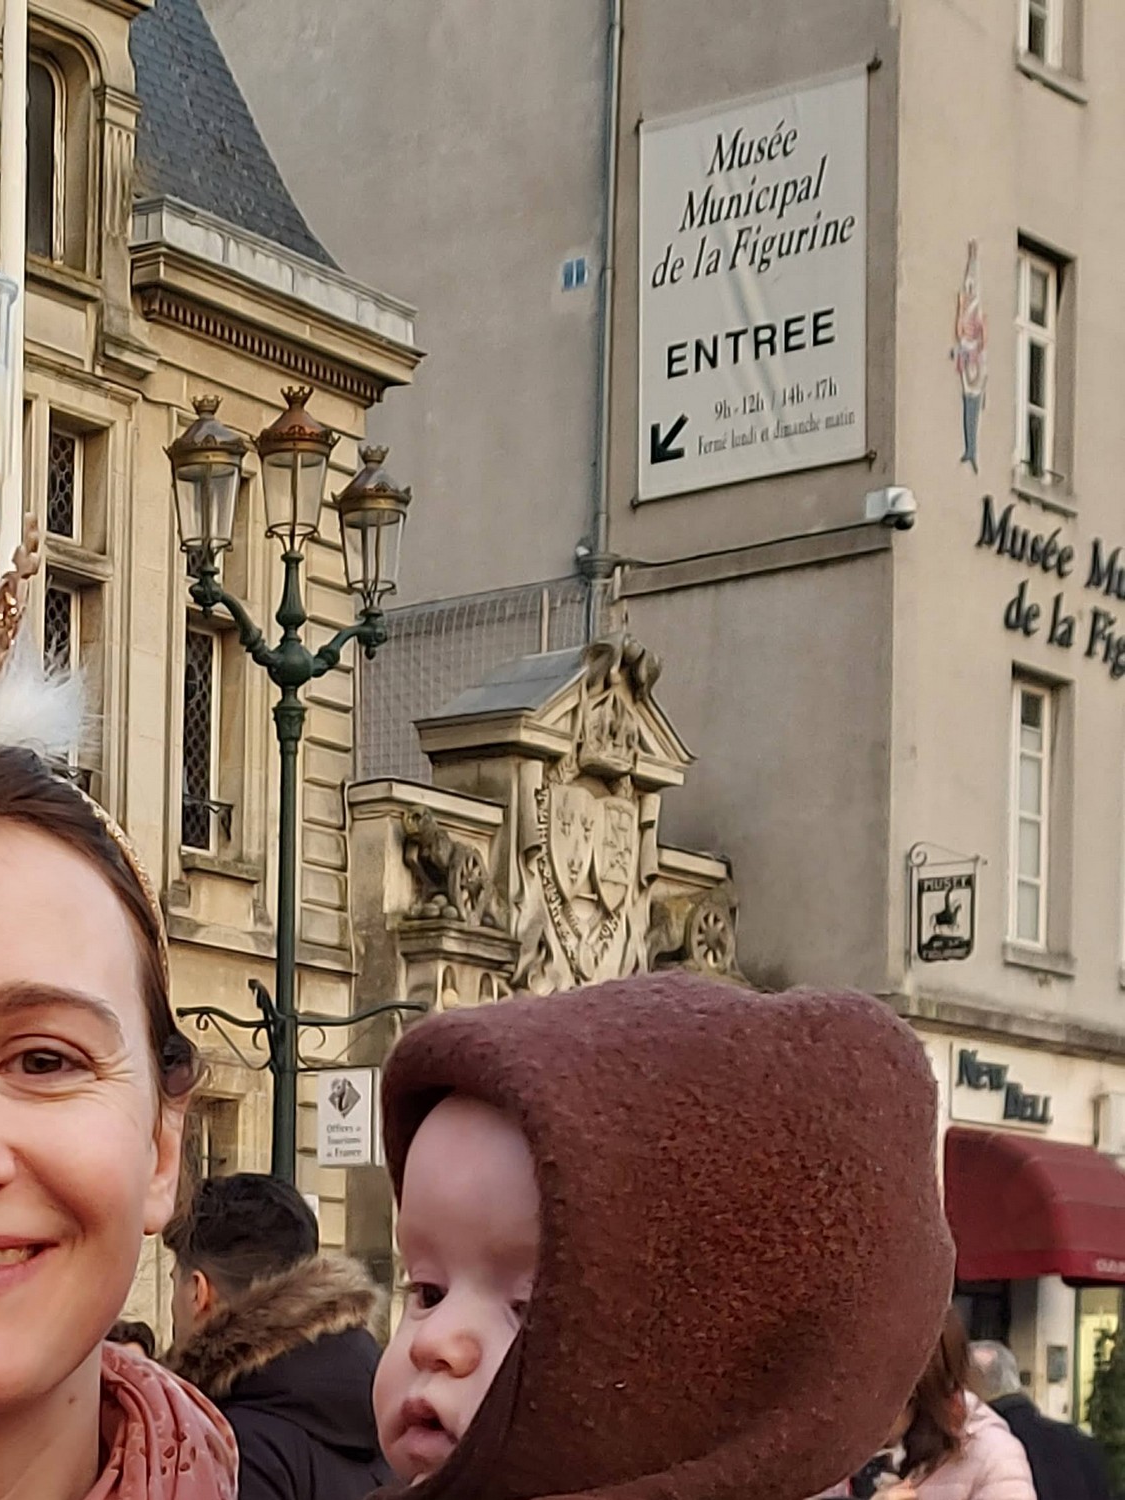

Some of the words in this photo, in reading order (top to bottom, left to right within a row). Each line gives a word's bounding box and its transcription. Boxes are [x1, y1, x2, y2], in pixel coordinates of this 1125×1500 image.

[707, 119, 798, 176] Musée
[678, 155, 828, 231] Municipal
[651, 243, 685, 288] de
[693, 236, 722, 278] la
[728, 211, 856, 274] Figurine
[667, 308, 835, 379] ENTREE
[975, 495, 1074, 579] Musée
[1004, 579, 1040, 636] de
[1047, 592, 1075, 648] la
